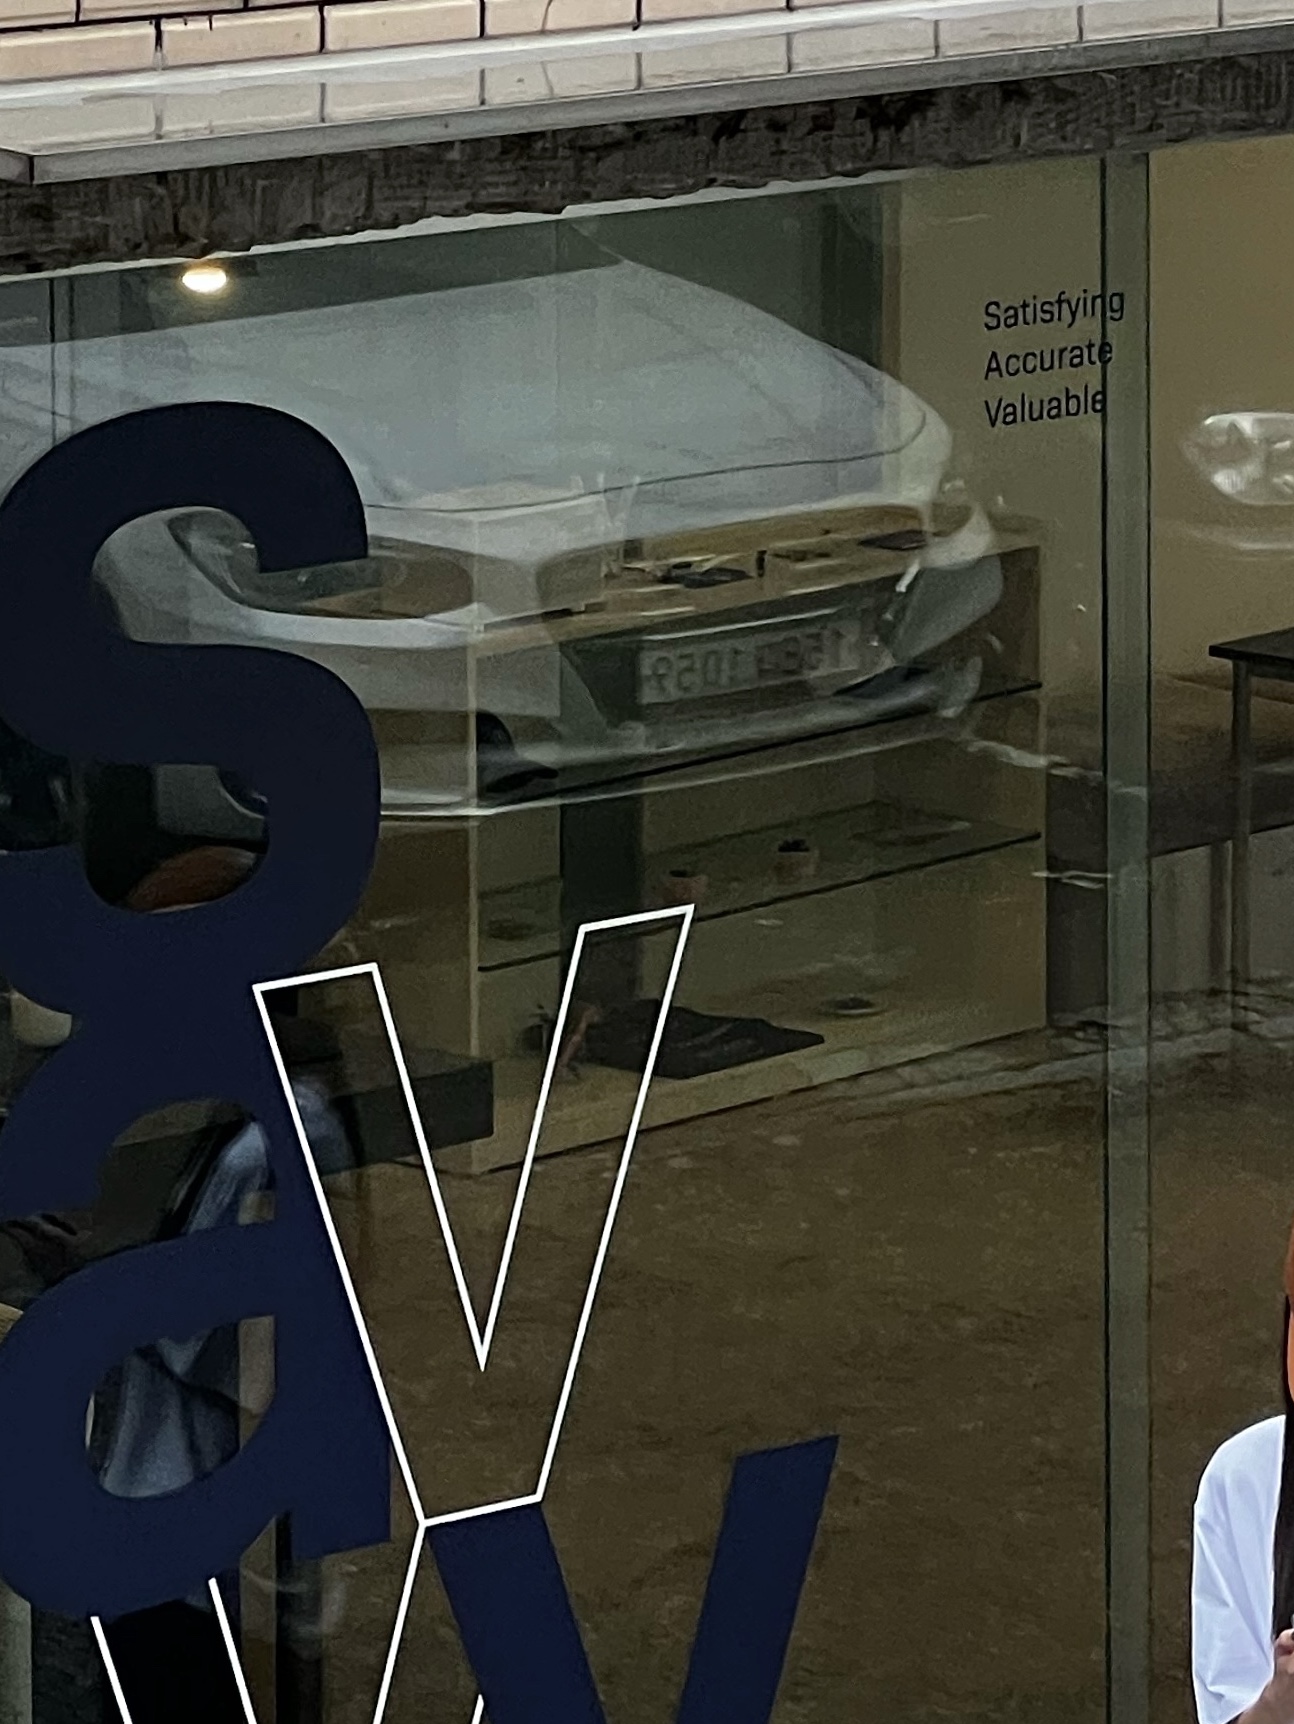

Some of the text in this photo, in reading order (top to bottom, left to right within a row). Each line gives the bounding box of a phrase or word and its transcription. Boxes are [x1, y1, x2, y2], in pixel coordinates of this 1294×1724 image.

[983, 289, 1125, 331] Satisfying
[984, 338, 1114, 381] Accurate
[984, 384, 1108, 429] Valuable
